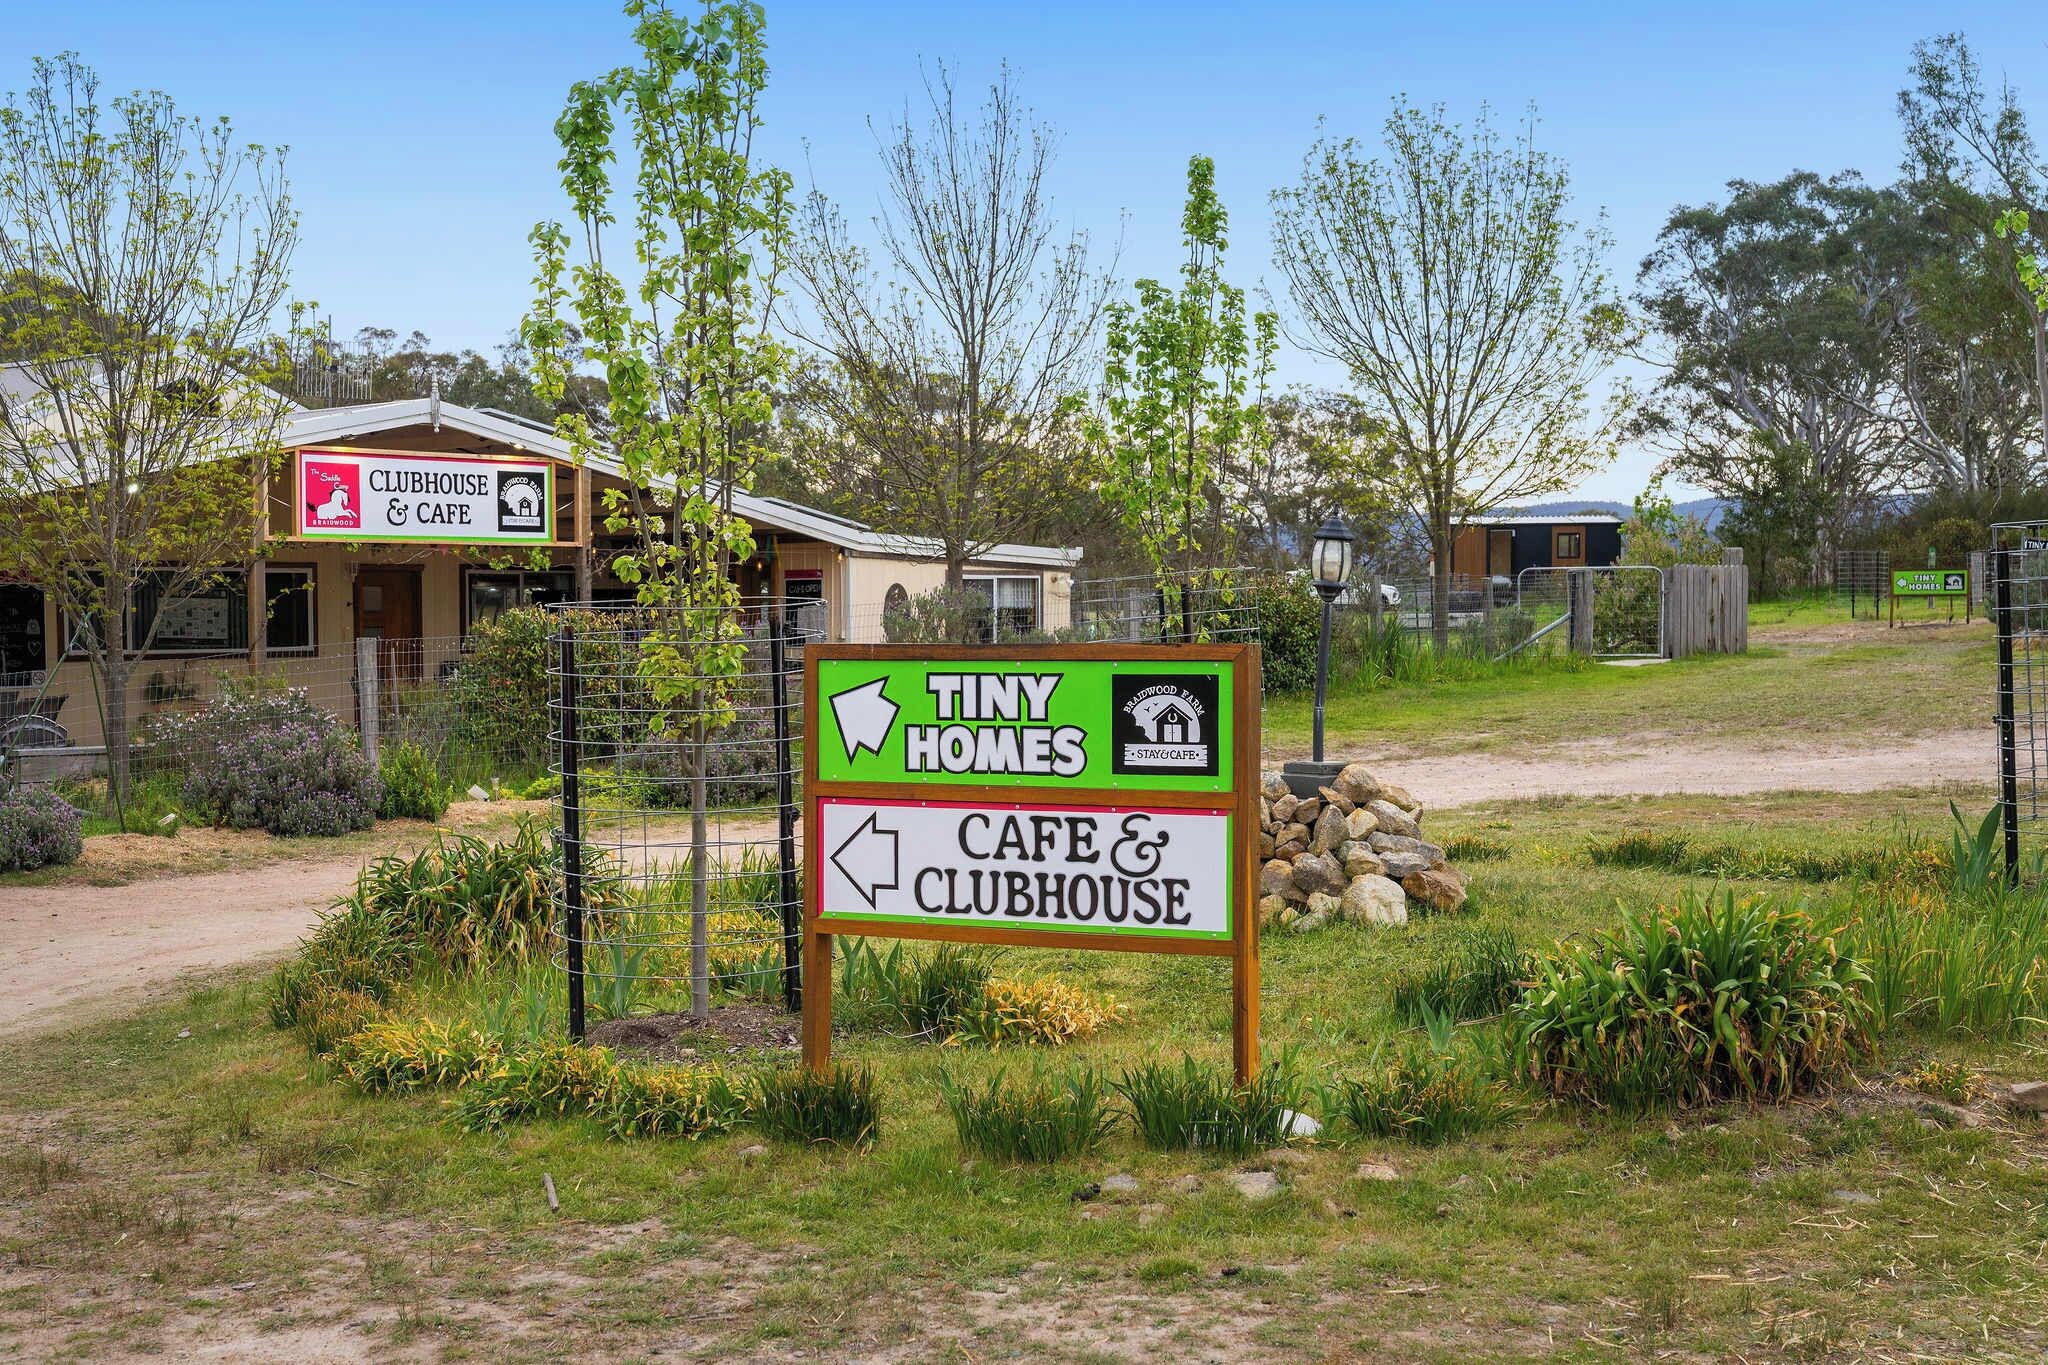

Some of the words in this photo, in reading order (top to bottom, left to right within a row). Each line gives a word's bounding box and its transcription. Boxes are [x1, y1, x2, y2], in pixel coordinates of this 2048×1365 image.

[369, 469, 489, 496] CLUBHOUSE
[386, 498, 409, 527] &
[416, 502, 472, 525] CAFE
[2027, 541, 2045, 550] TINY
[1908, 583, 1941, 591] HOMES
[1914, 574, 1936, 582] TINY
[927, 672, 1063, 722] TINY
[1123, 685, 1177, 714] BRAIDWOOD
[1181, 689, 1205, 716] FARM
[905, 725, 1088, 778] HOMES
[958, 813, 1100, 863] CAFE
[1110, 814, 1170, 878] &
[914, 866, 1192, 926] CLUBHOUSE
